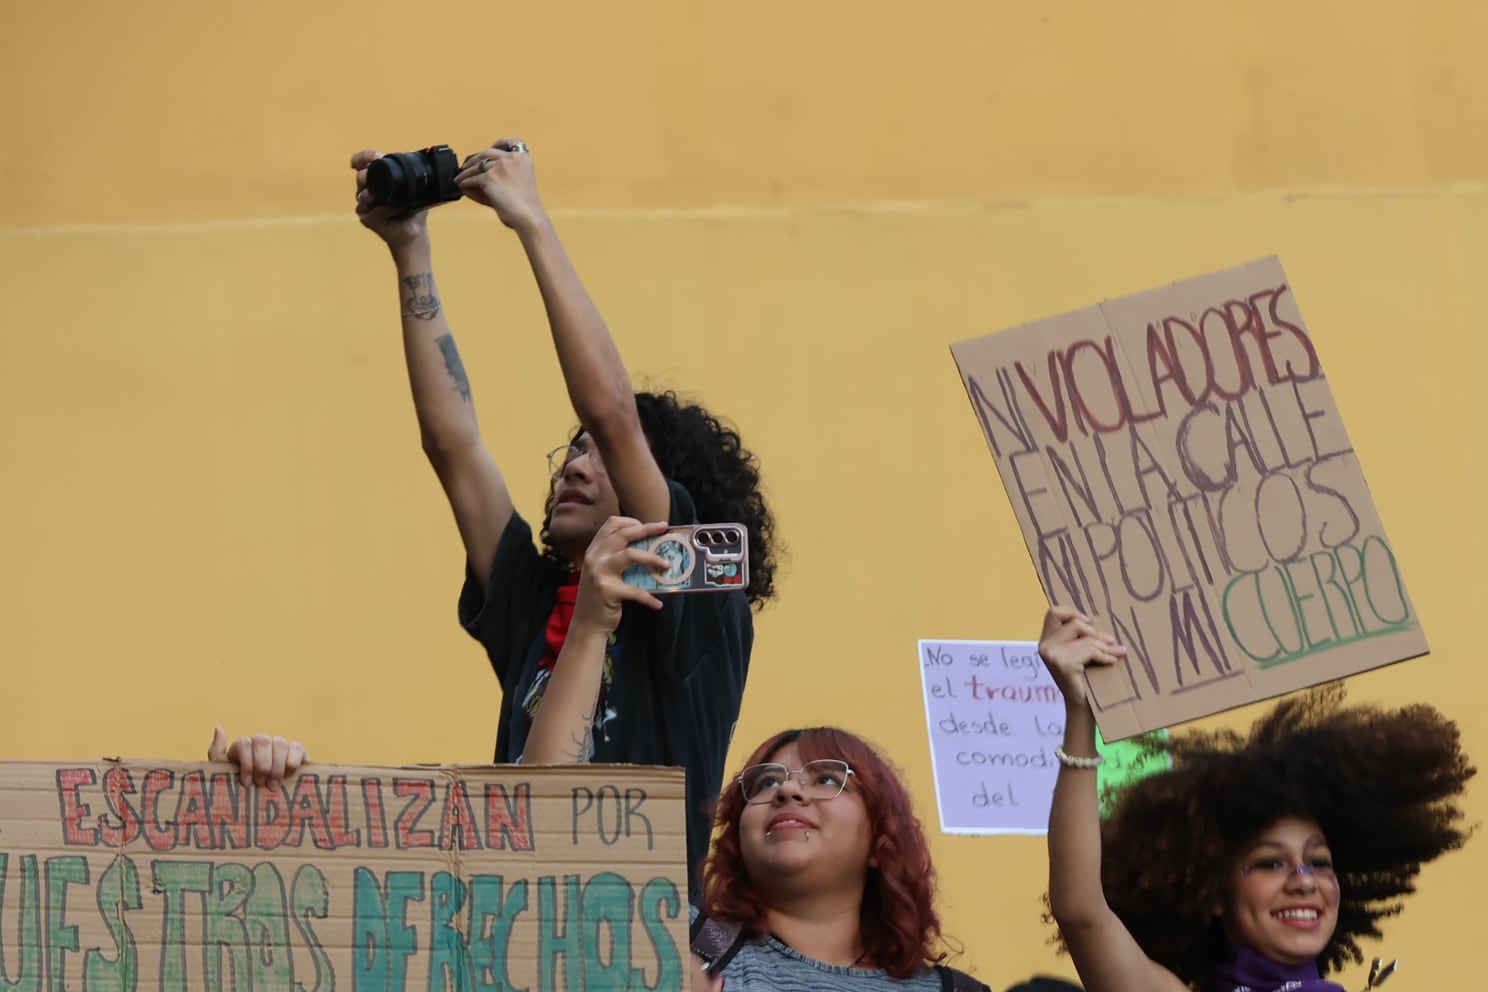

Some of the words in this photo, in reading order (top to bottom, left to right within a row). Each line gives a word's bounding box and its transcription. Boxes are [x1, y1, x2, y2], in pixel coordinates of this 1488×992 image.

[968, 366, 1039, 458] NI
[1014, 284, 1320, 443] VIOLADORES
[1009, 440, 1103, 538] EN
[1093, 422, 1178, 515] LA
[1175, 361, 1355, 491] CALLE
[1038, 527, 1099, 617] NI
[1169, 590, 1232, 687] MI
[1222, 535, 1411, 662] CUERPO
[926, 646, 953, 667] No
[969, 654, 990, 667] se
[931, 677, 957, 699] el
[963, 674, 1062, 704] traum
[939, 712, 1010, 736] desde
[55, 767, 534, 851] ESCANDALIZAN
[571, 785, 654, 850] POR
[972, 781, 1020, 809] del
